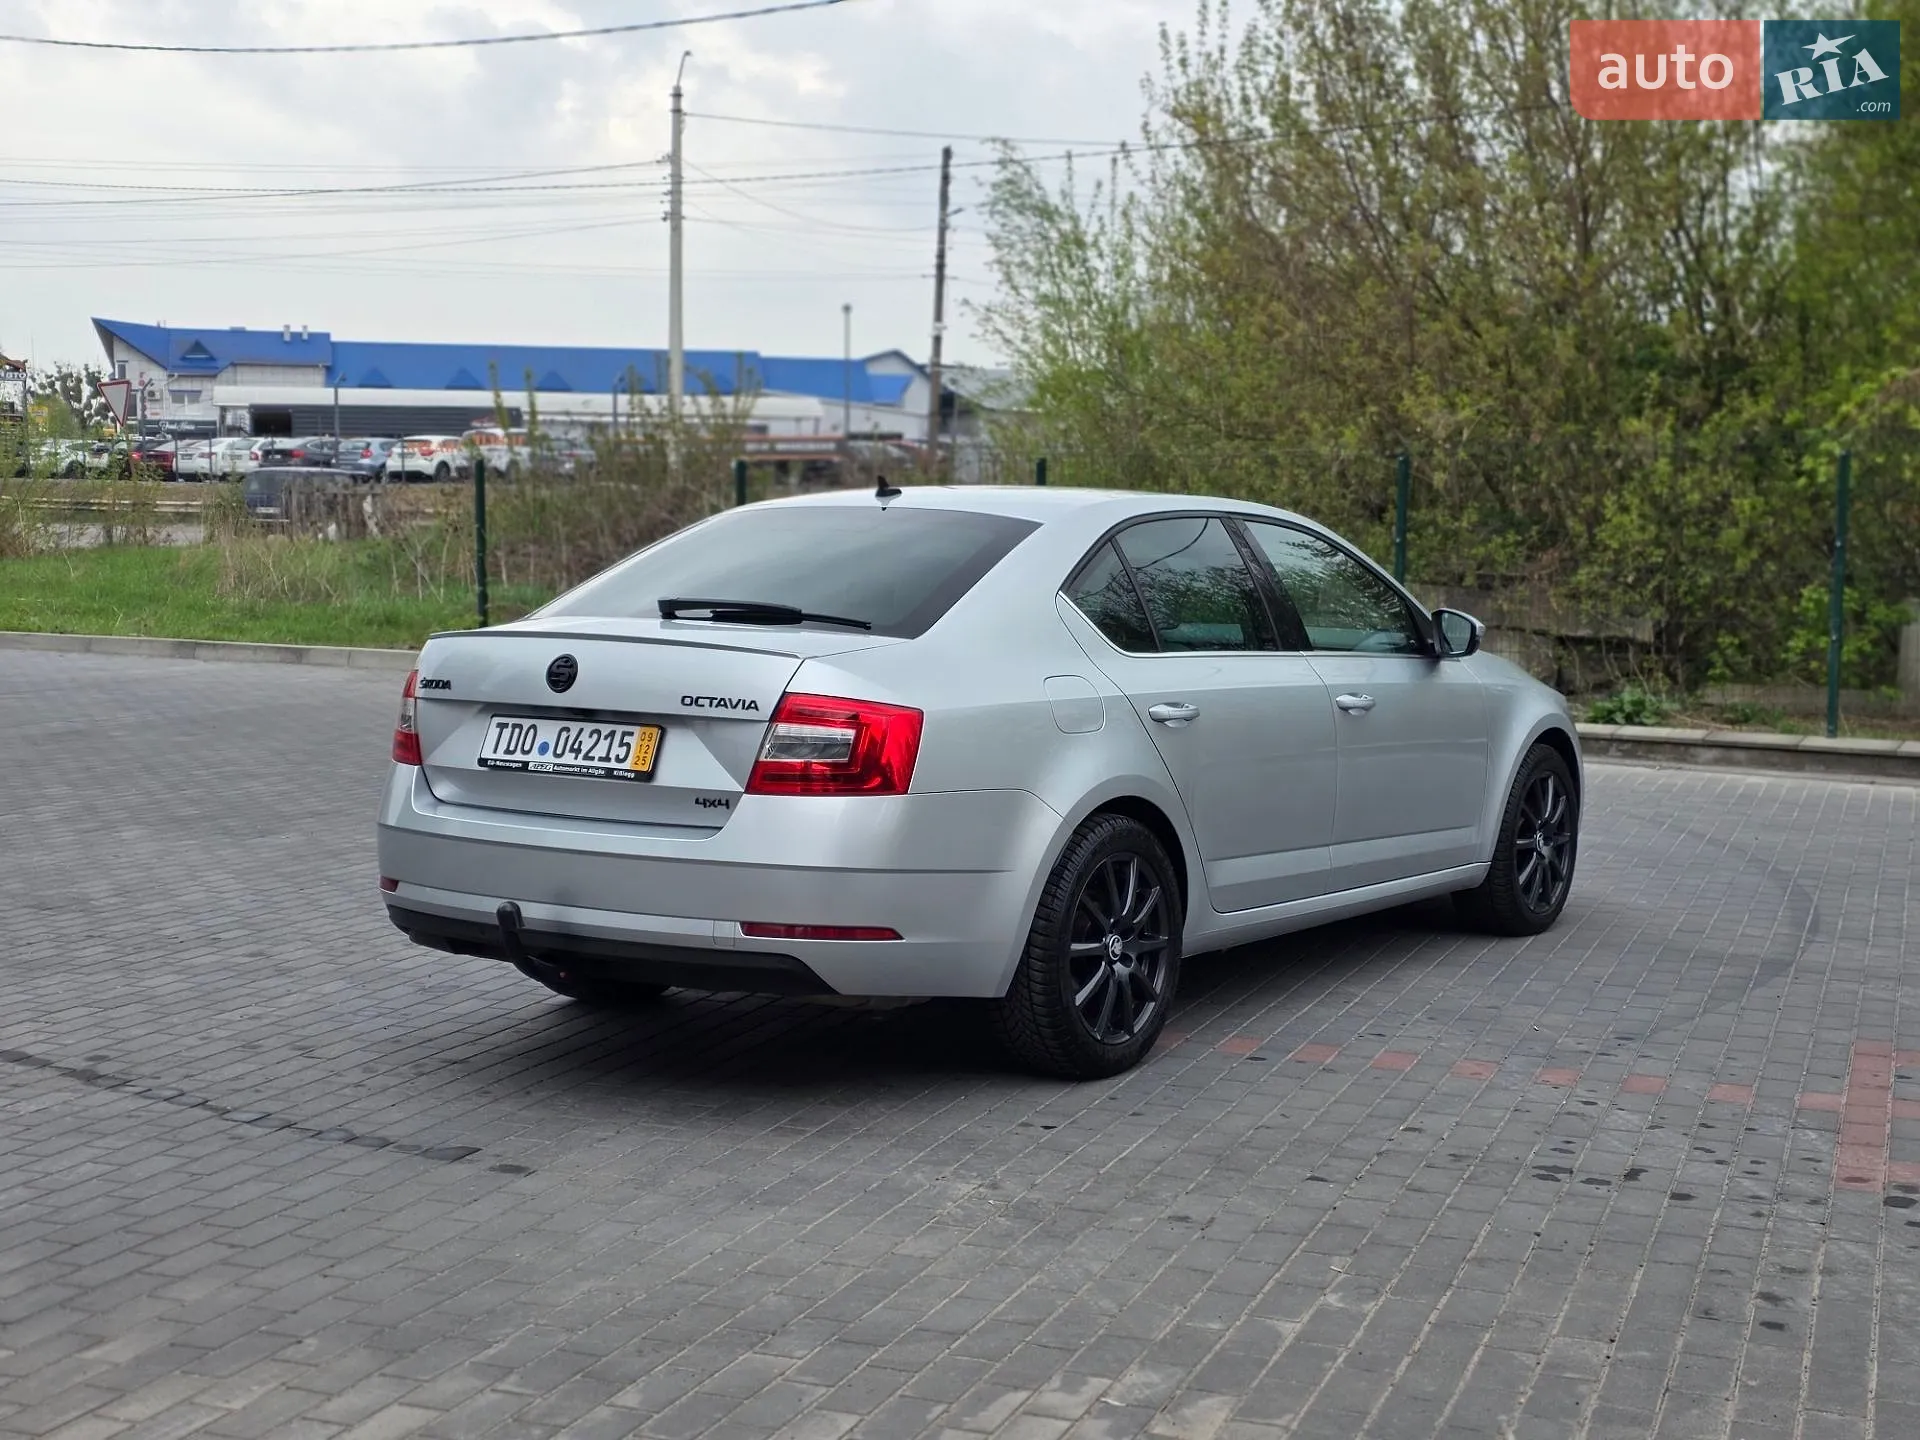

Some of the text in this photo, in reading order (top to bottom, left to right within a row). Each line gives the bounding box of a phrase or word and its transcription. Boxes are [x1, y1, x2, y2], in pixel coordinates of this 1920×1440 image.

[680, 695, 759, 712] OCTAVIA
[492, 721, 635, 764] TDO 04215
[640, 731, 653, 742] 09
[638, 743, 650, 755] 12
[634, 755, 648, 766] 25
